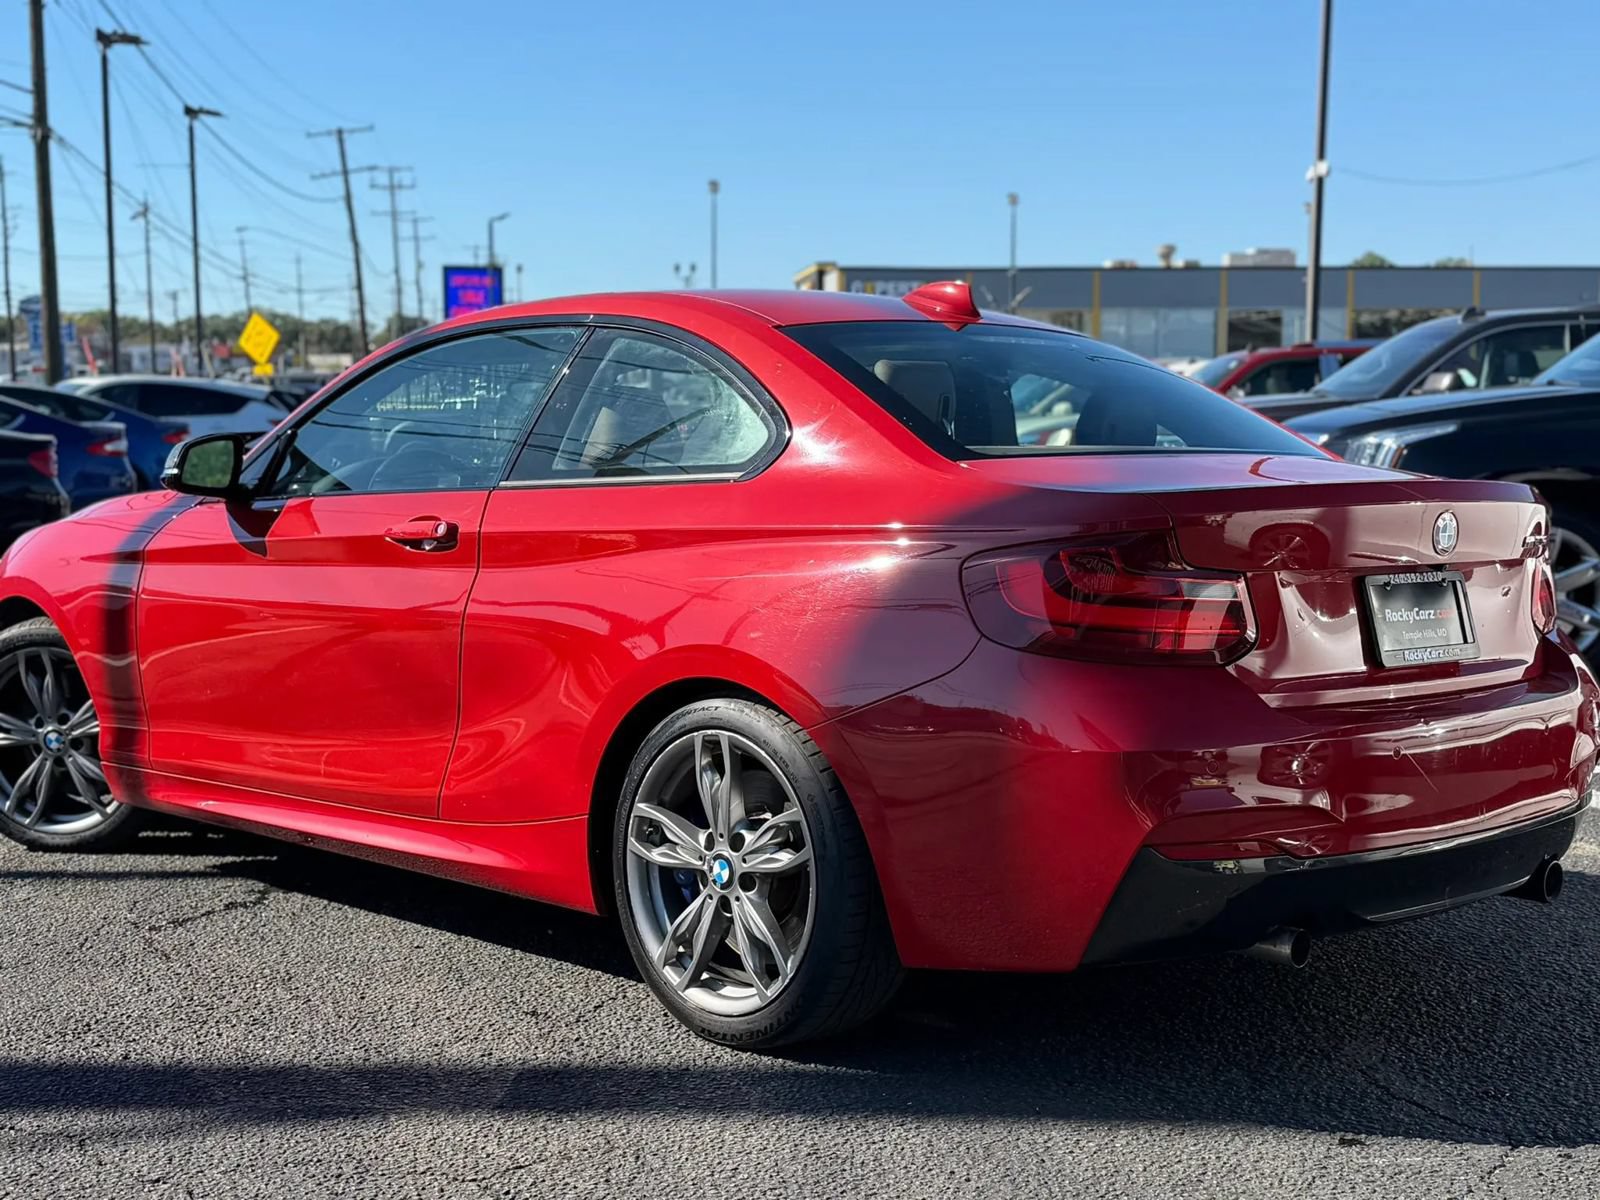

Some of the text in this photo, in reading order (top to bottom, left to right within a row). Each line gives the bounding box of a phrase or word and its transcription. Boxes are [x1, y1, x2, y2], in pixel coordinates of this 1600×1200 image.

[1402, 630, 1422, 641] Temple
[1437, 628, 1448, 637] MD
[1404, 648, 1460, 662] RockyCarz.com
